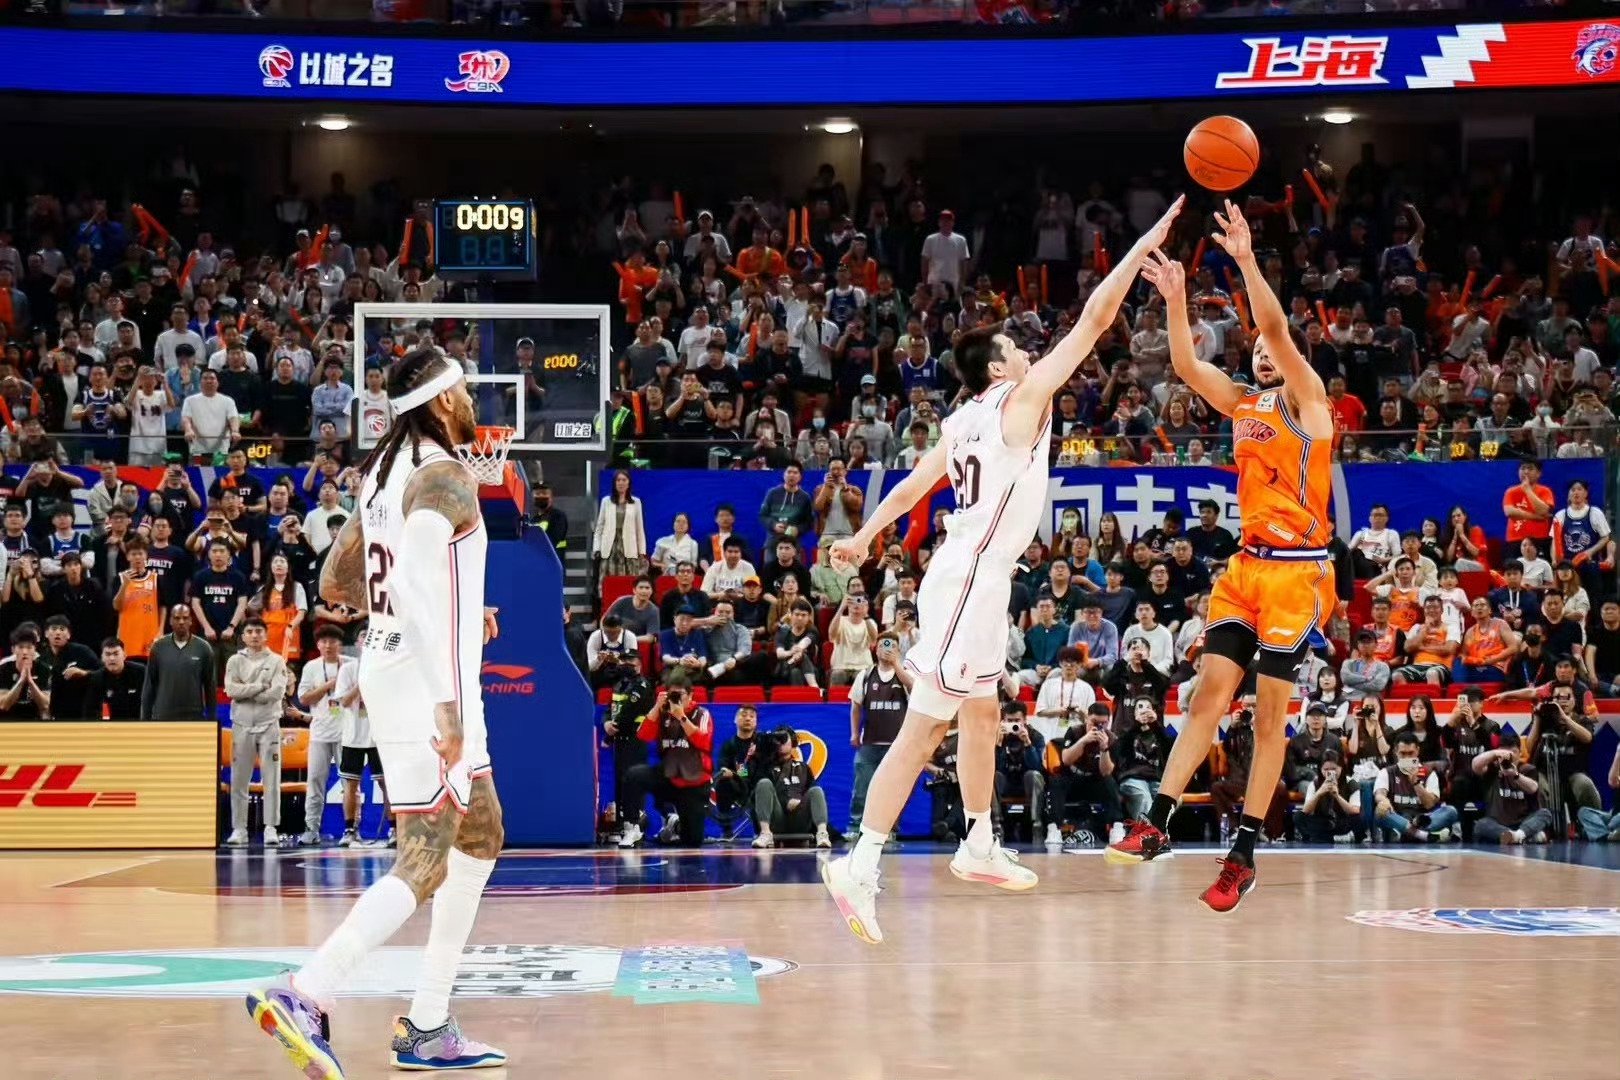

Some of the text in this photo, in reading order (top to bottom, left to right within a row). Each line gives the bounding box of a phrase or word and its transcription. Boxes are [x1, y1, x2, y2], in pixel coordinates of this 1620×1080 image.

[300, 52, 393, 87] 以城之名
[1216, 35, 1389, 88] 上海
